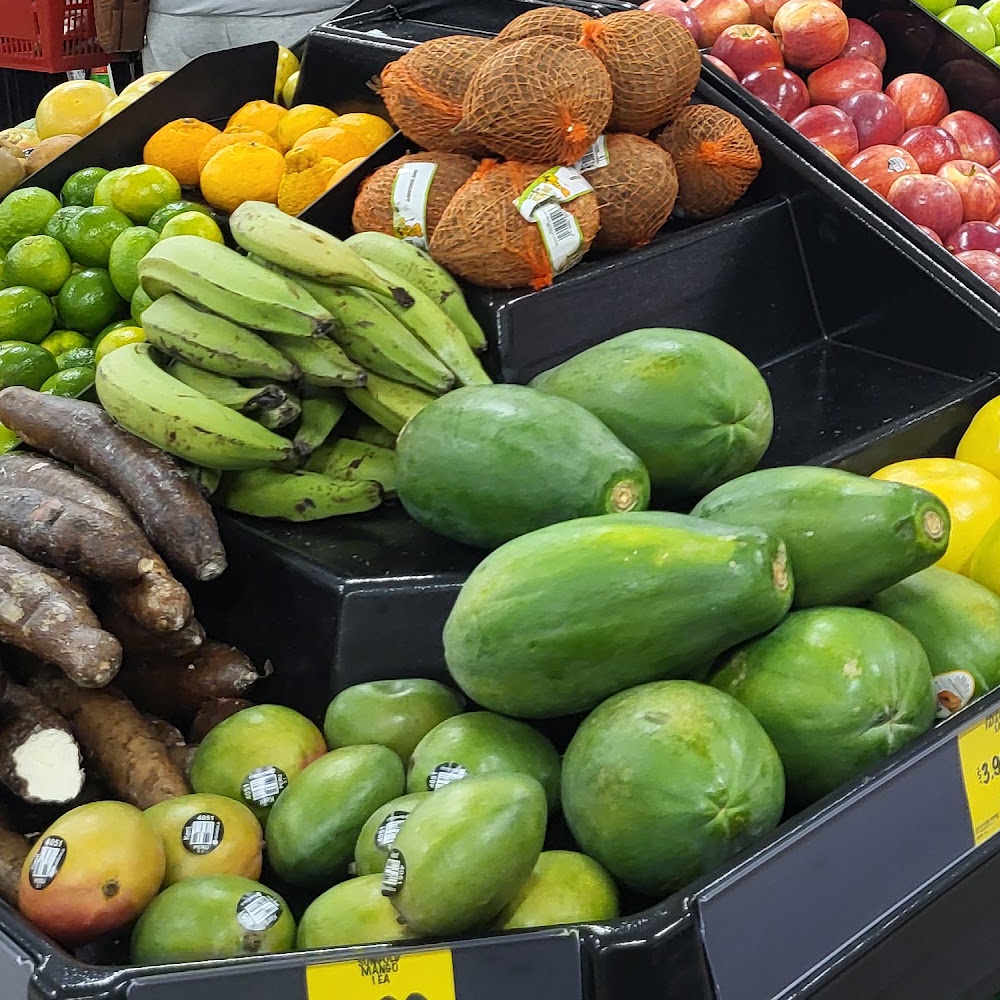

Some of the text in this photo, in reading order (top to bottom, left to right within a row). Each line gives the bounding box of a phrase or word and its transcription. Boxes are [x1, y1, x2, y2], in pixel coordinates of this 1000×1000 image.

[44, 838, 63, 847] 4051
[361, 963, 399, 977] MANGO
[378, 974, 390, 984] EA
